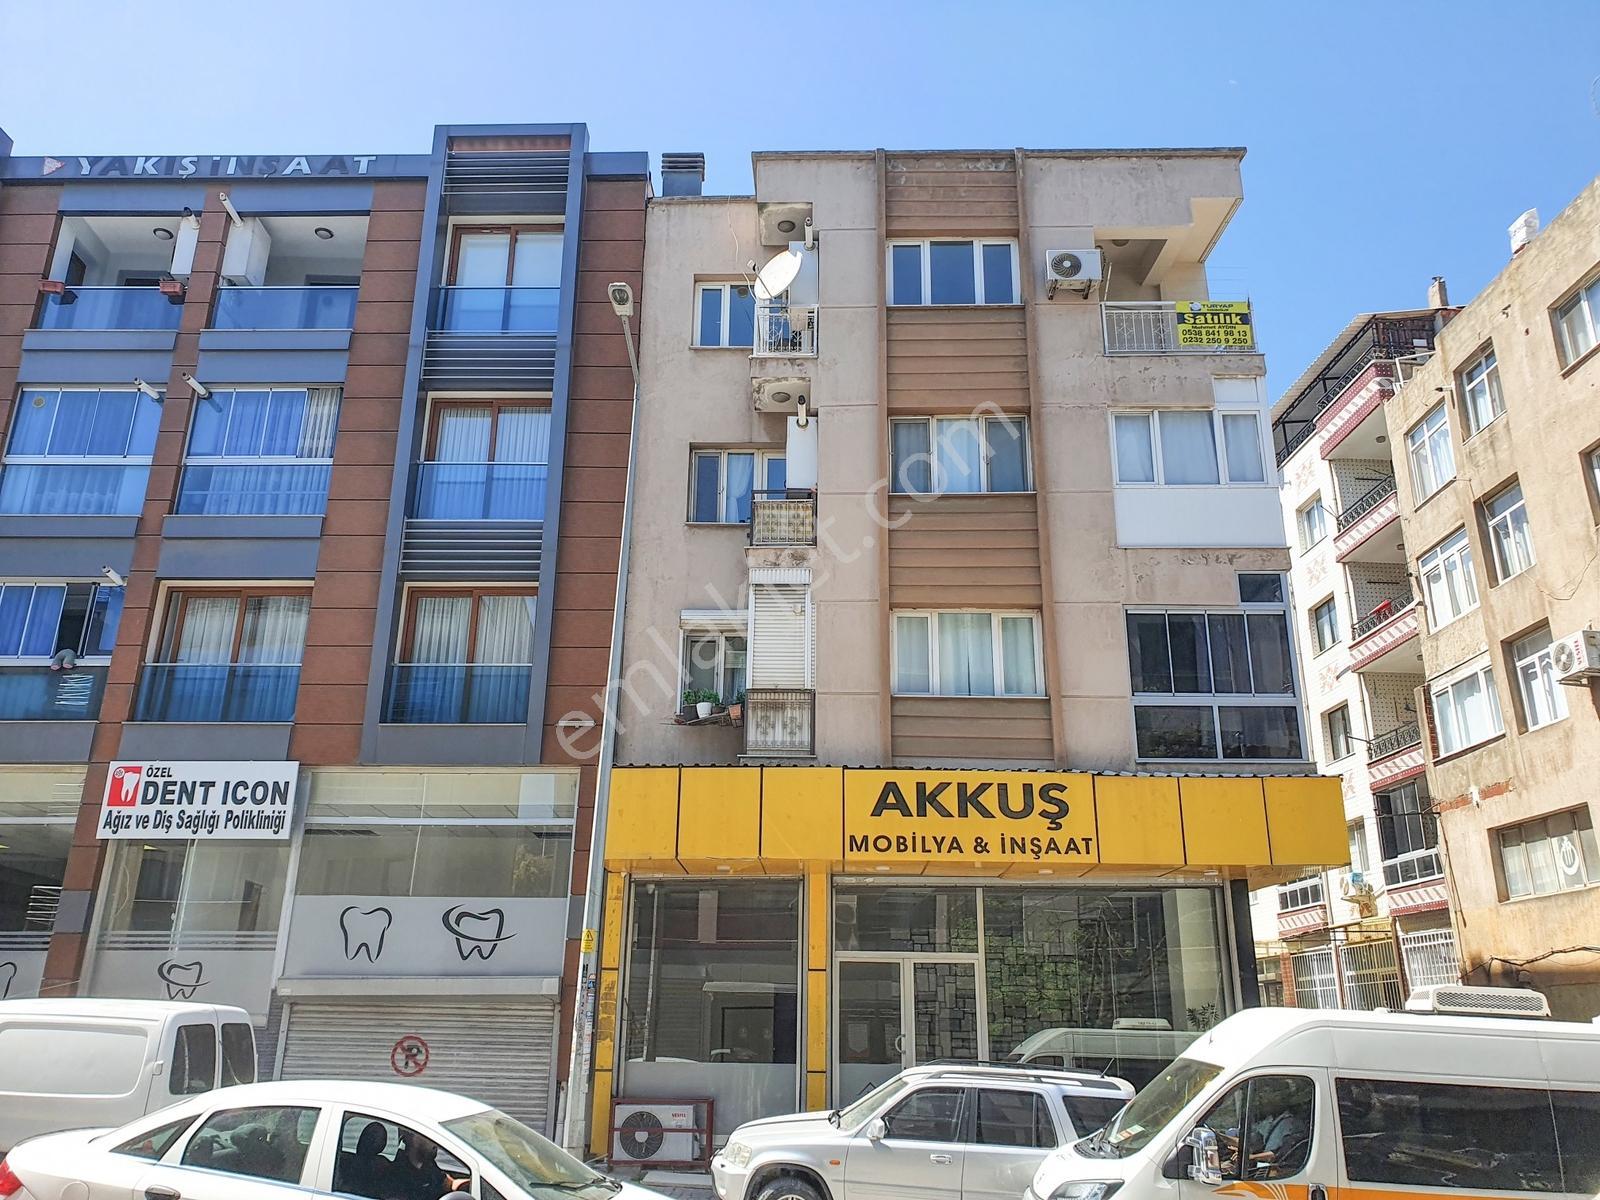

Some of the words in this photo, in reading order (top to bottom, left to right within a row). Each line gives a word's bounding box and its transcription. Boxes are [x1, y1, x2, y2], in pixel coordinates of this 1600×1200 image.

[78, 156, 198, 179] YAKIŞ
[1183, 313, 1242, 324] Satılık
[1182, 329, 1202, 337] 0538
[146, 765, 173, 778] ÖZEL
[140, 781, 215, 805] DENT
[221, 781, 290, 805] ICON
[870, 781, 1070, 831] AKKUŞ
[103, 809, 131, 835] Ağız
[135, 814, 150, 829] ve
[153, 809, 173, 833] Diş
[176, 809, 220, 835] Sağlığı
[224, 809, 286, 835] Polikliniği
[849, 832, 964, 854] MOBİLYA
[973, 836, 991, 854] &
[1000, 832, 1093, 860] İNŞAAT
